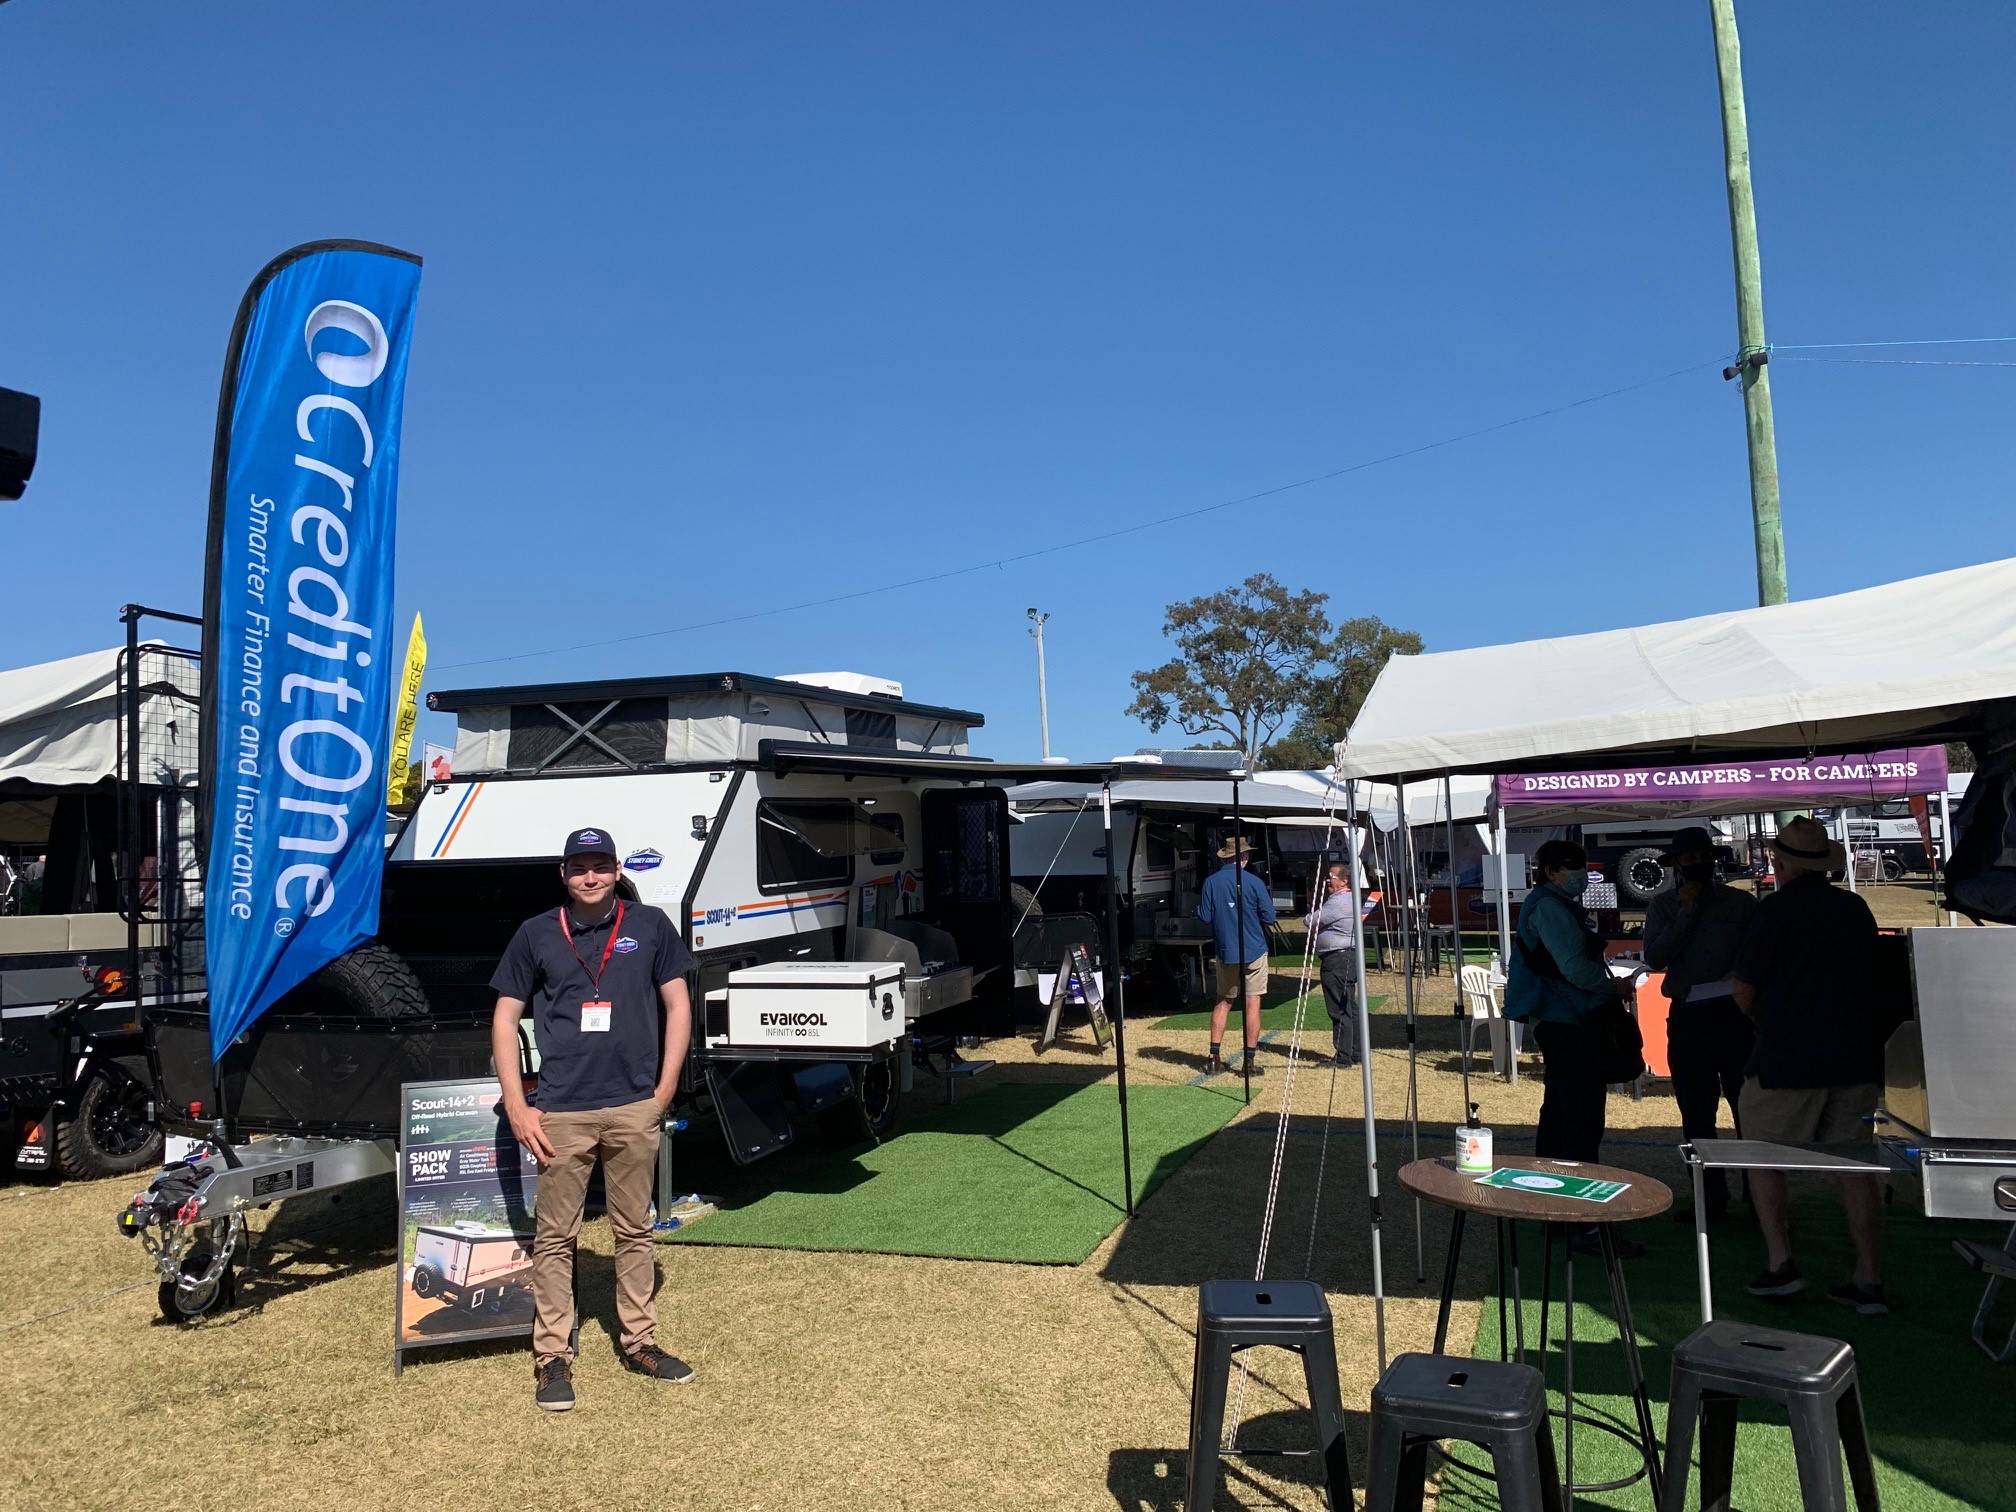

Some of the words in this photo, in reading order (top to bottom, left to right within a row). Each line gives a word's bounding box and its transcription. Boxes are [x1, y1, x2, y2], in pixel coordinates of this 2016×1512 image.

[247, 493, 276, 605] Smarter
[241, 609, 270, 717] Finance
[407, 659, 425, 705] HERE
[398, 707, 417, 743] ARE
[238, 725, 261, 777] and
[392, 747, 408, 781] YOU
[1524, 773, 1621, 791] DESIGNED
[1624, 772, 1650, 787] BY
[1653, 768, 1752, 786] CAMPERS
[1769, 766, 1812, 782] FOR
[1814, 761, 1918, 781] CAMPERS
[230, 785, 260, 921] Insurance
[765, 1027, 795, 1037] INFINITY
[807, 1028, 821, 1037] 85L
[411, 1094, 475, 1111] Scout-14+2
[436, 1110, 455, 1119] Hybrid
[455, 1109, 479, 1117] Caravan
[409, 1149, 452, 1164] SHOW
[412, 1161, 449, 1176] PACK
